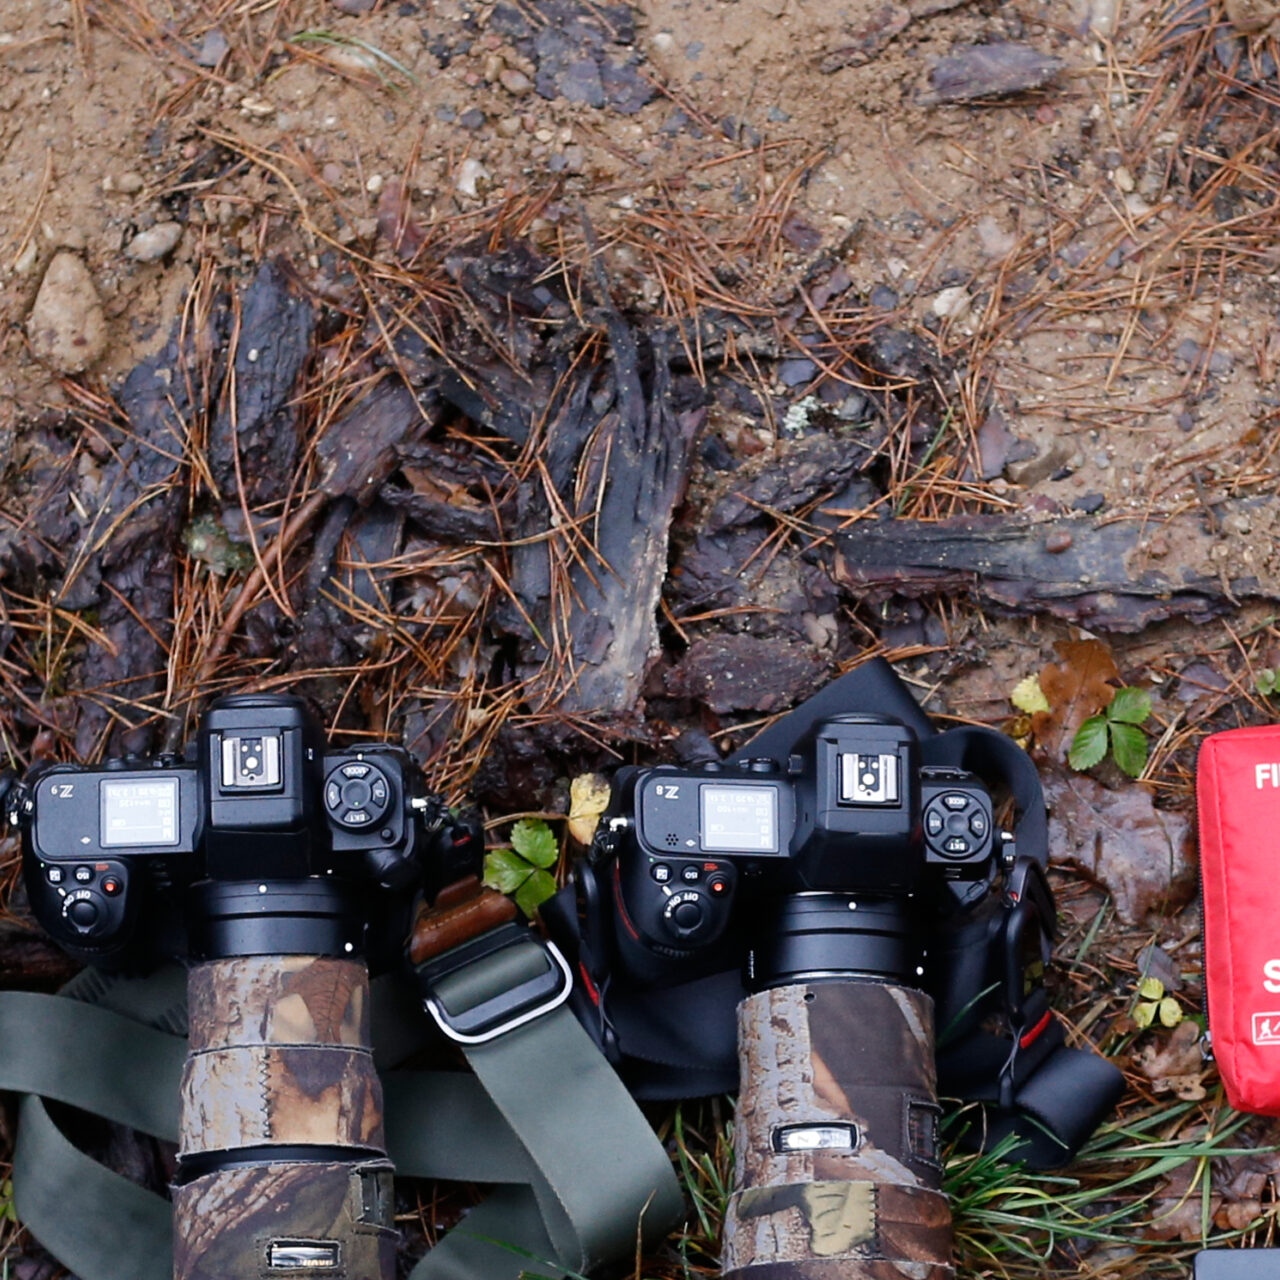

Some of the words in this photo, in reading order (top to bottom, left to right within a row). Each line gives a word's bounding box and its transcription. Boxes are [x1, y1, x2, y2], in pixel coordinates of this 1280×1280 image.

[76, 871, 90, 880] ISO
[685, 871, 698, 879] ISO
[76, 890, 91, 899] OFF
[682, 892, 699, 901] OFF
